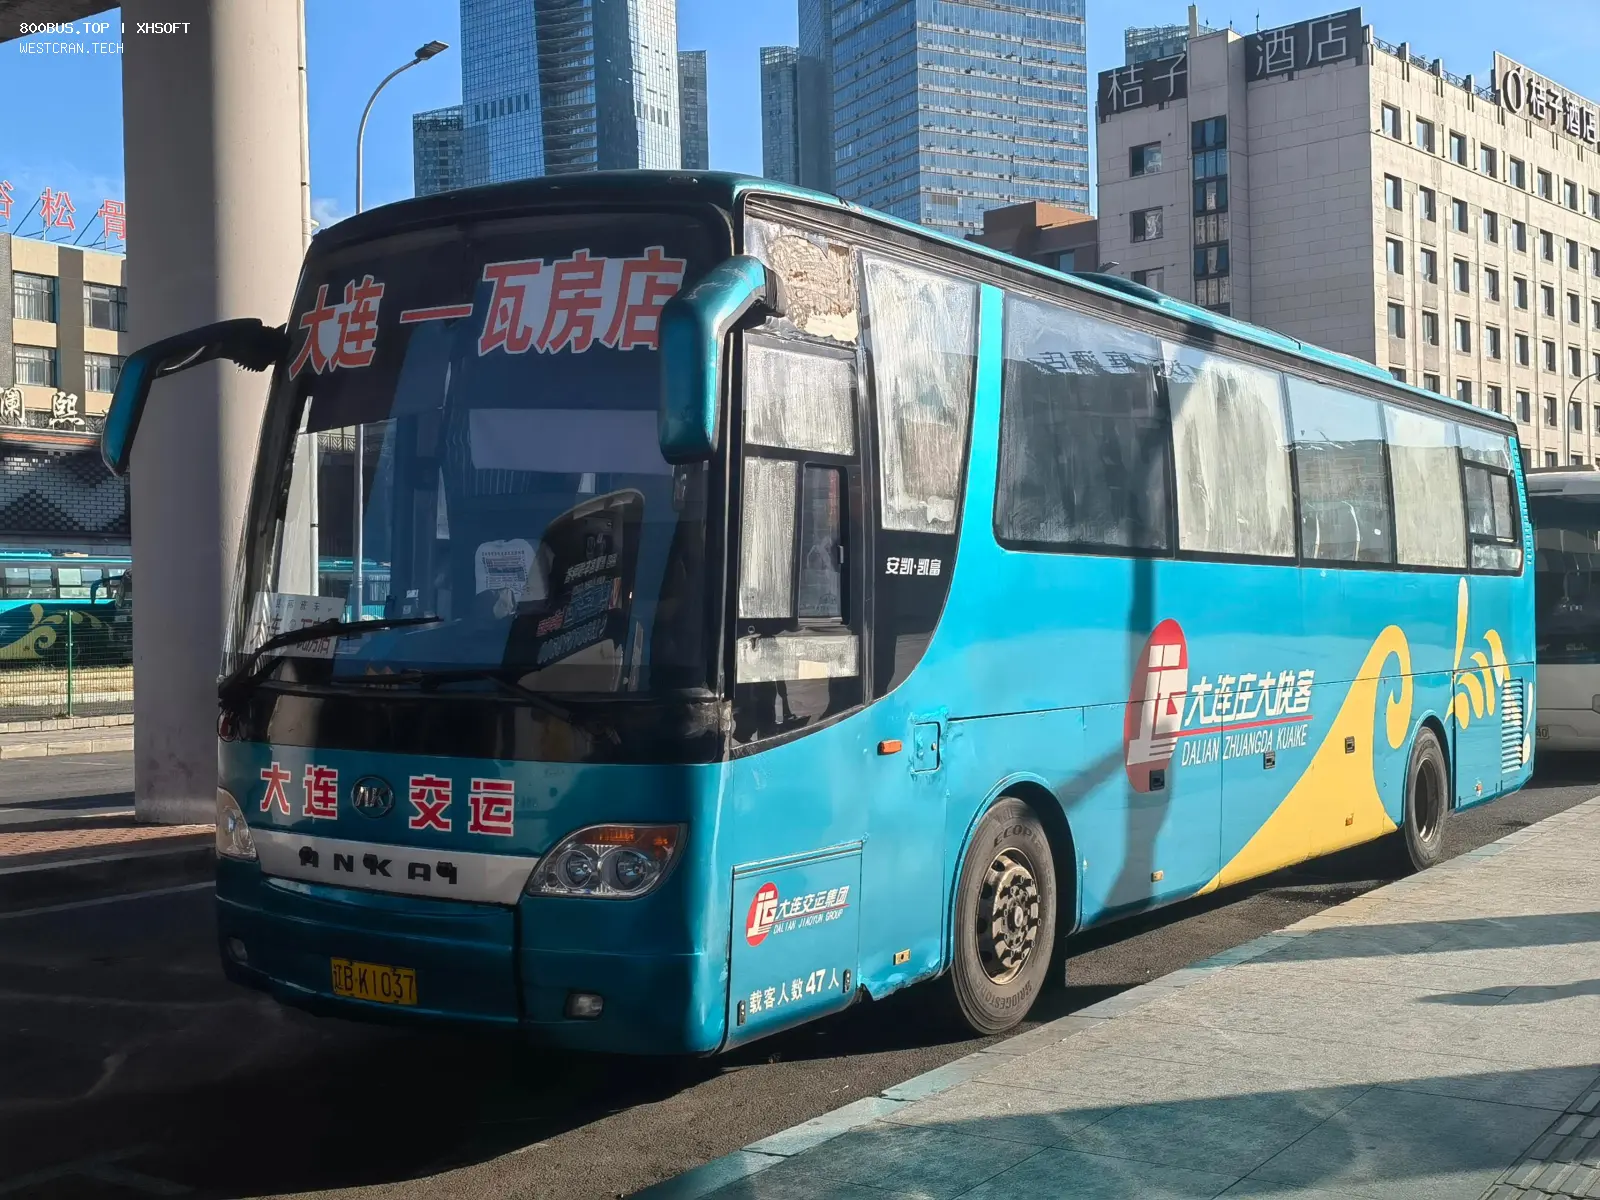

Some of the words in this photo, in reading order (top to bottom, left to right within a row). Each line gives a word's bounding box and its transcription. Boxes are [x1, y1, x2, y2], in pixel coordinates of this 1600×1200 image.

[1256, 13, 1347, 76] 酒店
[1107, 53, 1187, 111] 桔子
[1528, 73, 1597, 143] 桔子酒店
[1184, 668, 1316, 727] 大连庄大快客
[1181, 737, 1221, 767] DALIAN
[1222, 729, 1274, 761] ZHUANGDA
[1276, 723, 1309, 751] KUAIKE
[260, 761, 339, 821] 大连
[408, 773, 515, 837] 交运
[773, 919, 797, 935] DALIAN
[798, 913, 824, 929] JIAOYUN
[825, 908, 844, 922] GROUP
[775, 885, 850, 920] 大连交运集团
